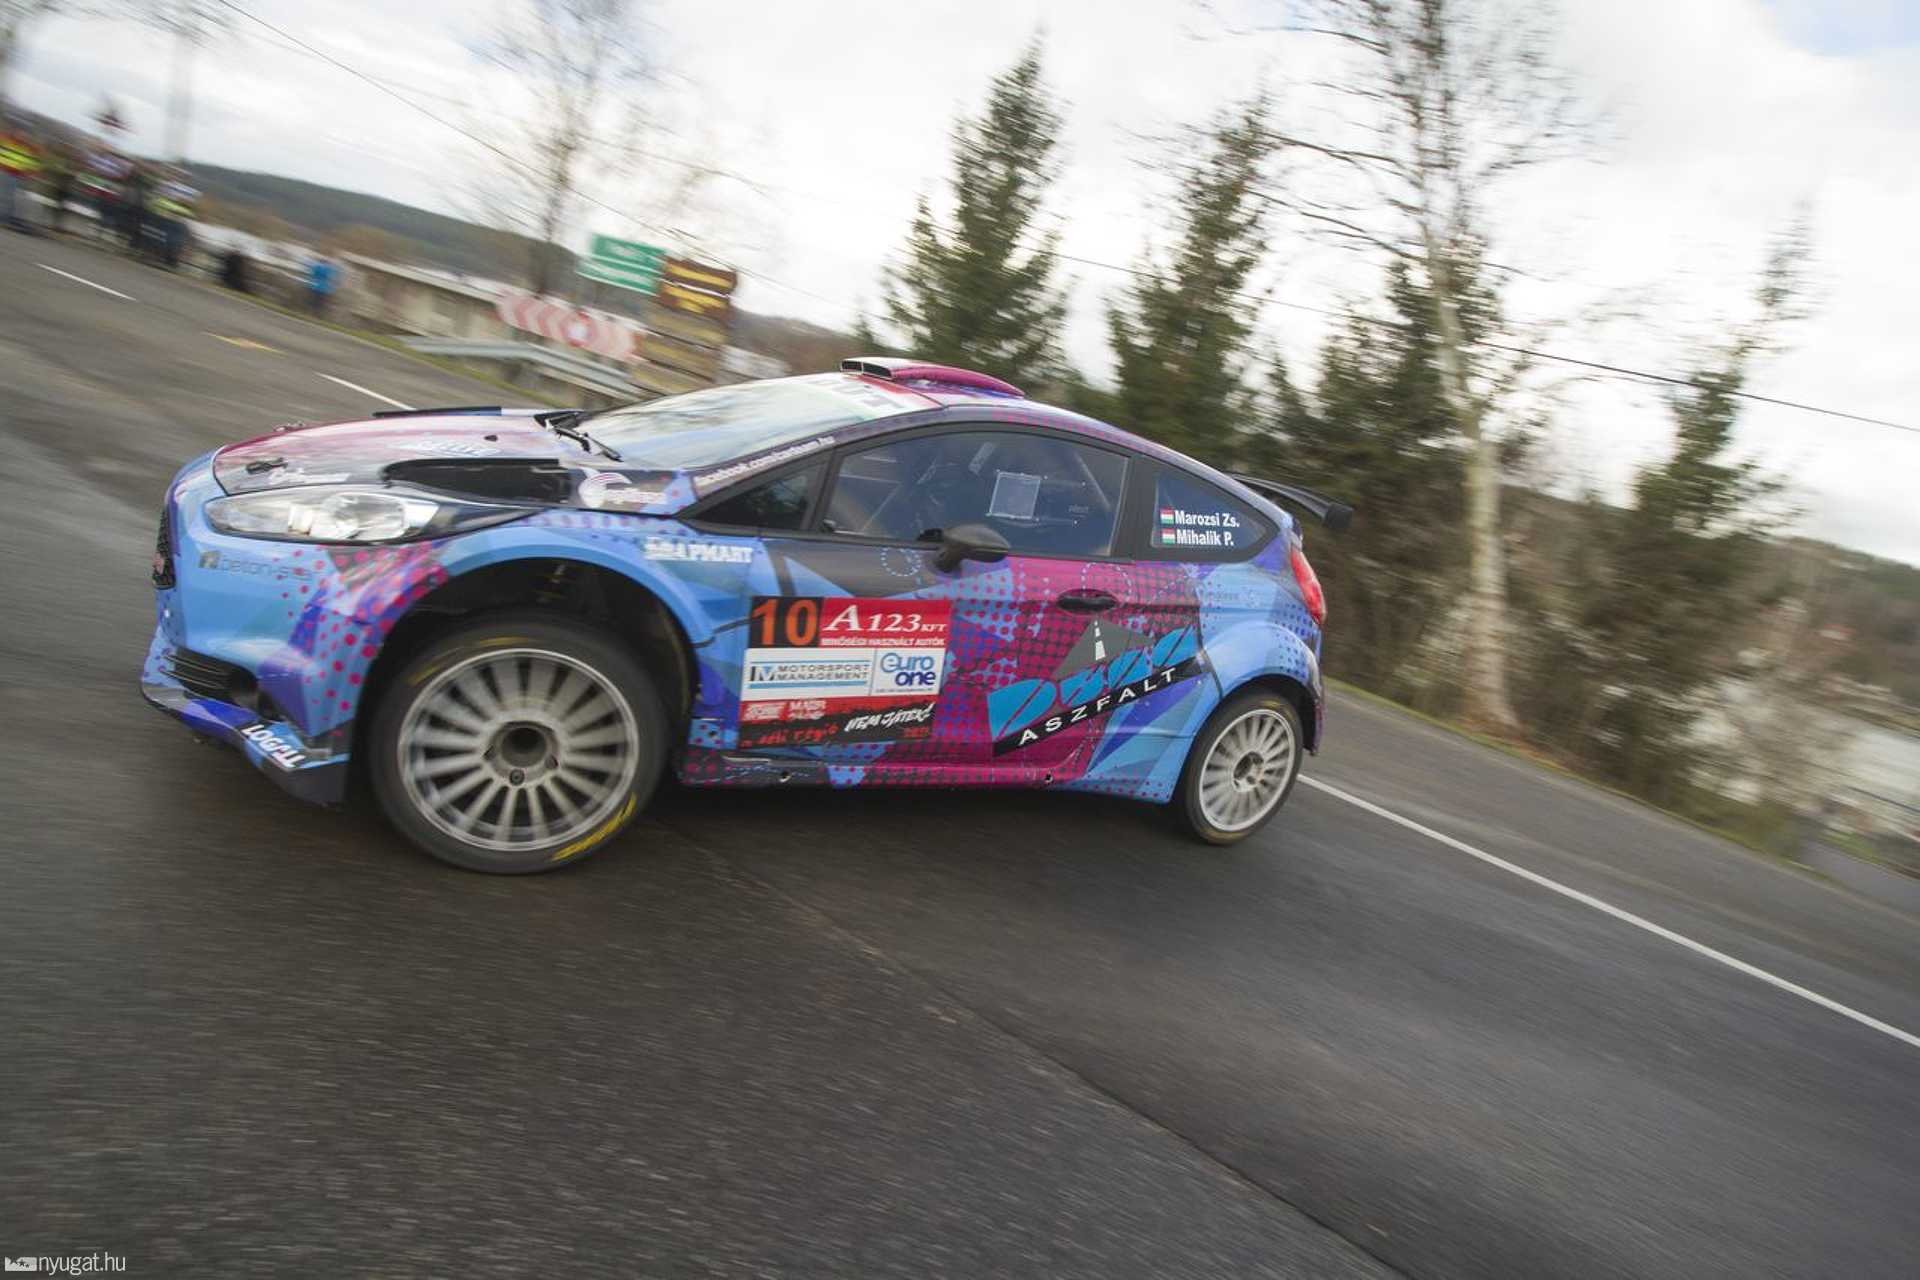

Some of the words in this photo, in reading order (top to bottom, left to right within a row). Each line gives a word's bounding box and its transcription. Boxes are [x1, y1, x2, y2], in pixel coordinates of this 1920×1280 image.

[1174, 510, 1220, 526] Marozsi
[1222, 513, 1240, 527] Zs.
[1176, 529, 1221, 545] Mihalik
[1224, 532, 1235, 546] P.
[751, 599, 818, 646] 10
[822, 604, 864, 631] A
[866, 613, 922, 632] 123
[921, 623, 947, 632] KFT
[775, 672, 868, 681] MANAGEMENT
[777, 664, 870, 673] MOTORSPORT
[895, 671, 937, 686] one
[1018, 667, 1177, 746] ASZFALT
